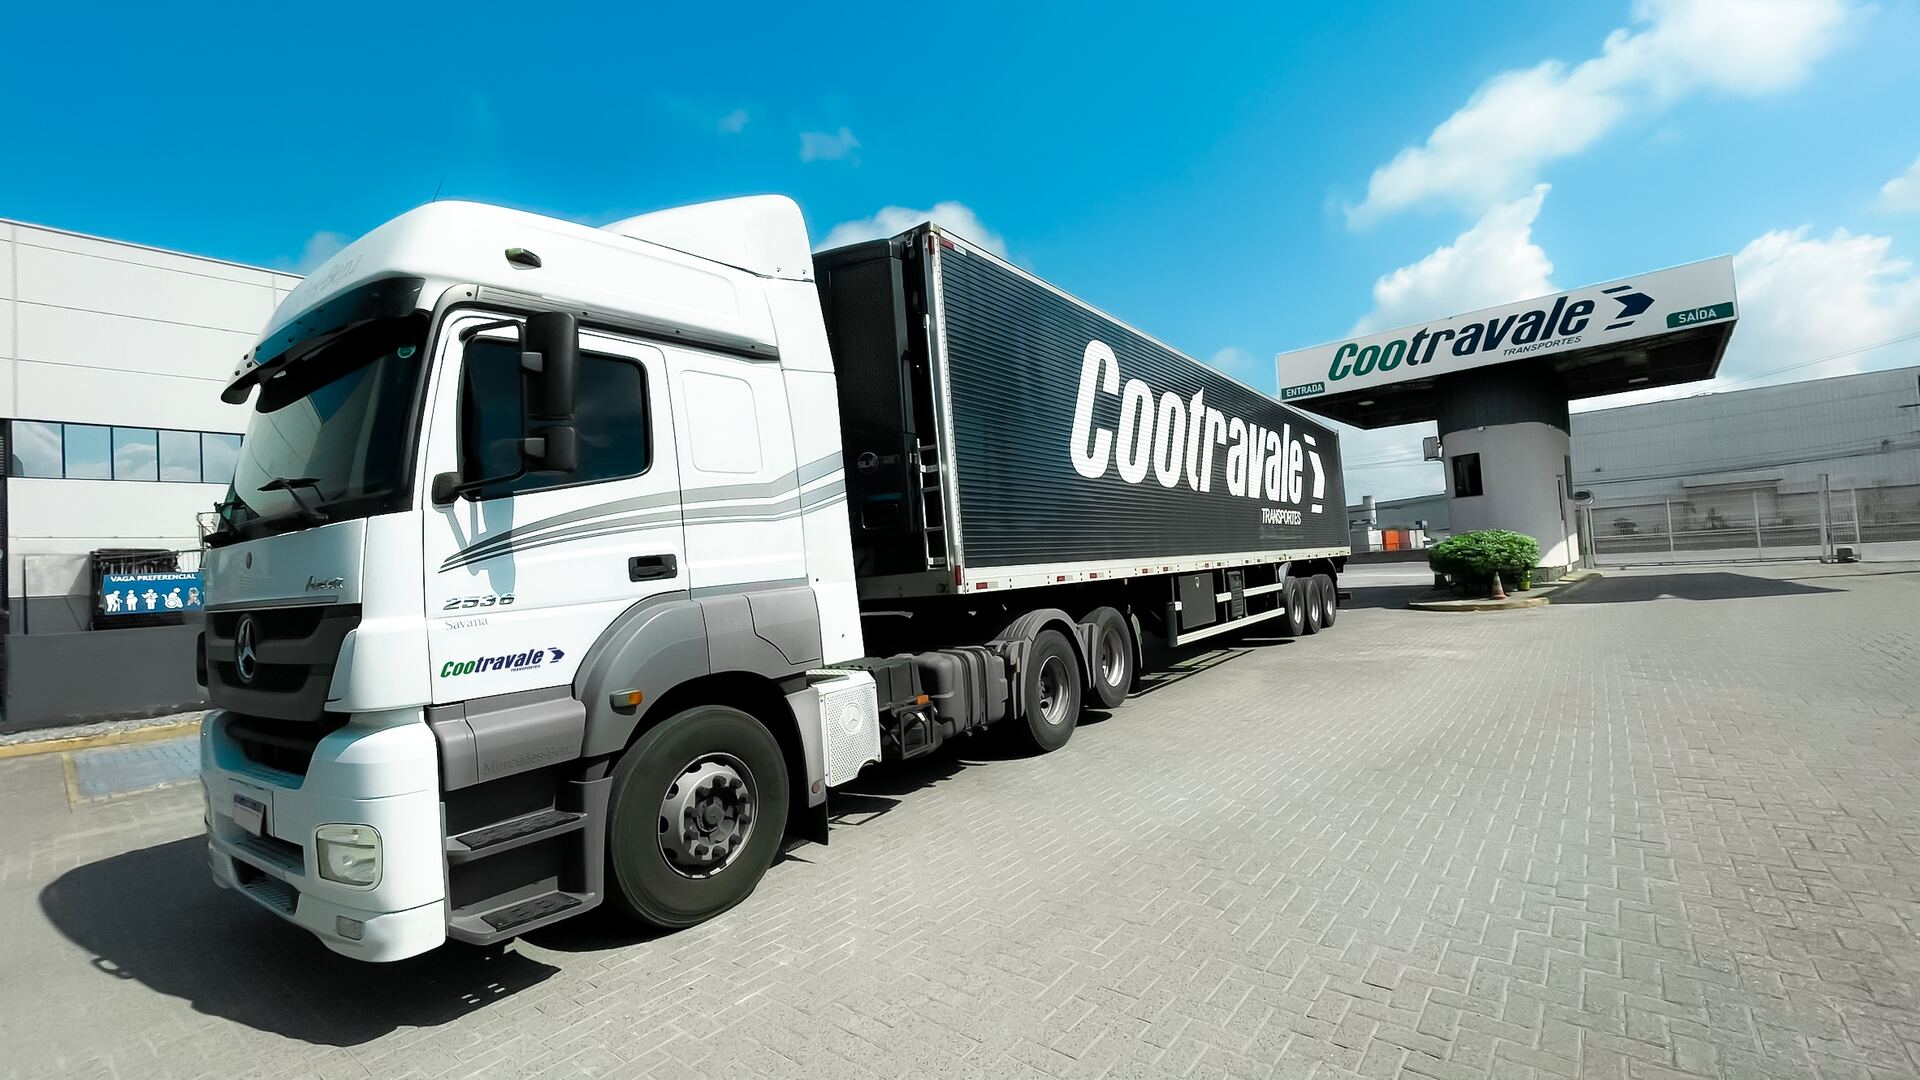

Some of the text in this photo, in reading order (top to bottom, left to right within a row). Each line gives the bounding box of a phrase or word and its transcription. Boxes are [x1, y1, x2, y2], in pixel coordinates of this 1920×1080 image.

[1678, 308, 1717, 323] SAÍDA
[1327, 296, 1595, 381] Cootravale
[1503, 336, 1582, 356] TRANSPORTES
[1286, 384, 1323, 397] ENTRADA
[1070, 339, 1303, 505] Cootravale
[1261, 508, 1302, 525] TRANSPORTES
[137, 573, 197, 581] PREFERENCIAL
[443, 594, 516, 610] 2536
[445, 617, 488, 631] Savana
[440, 649, 544, 678] Cootravale
[480, 744, 574, 775] Mercedes-Ben
